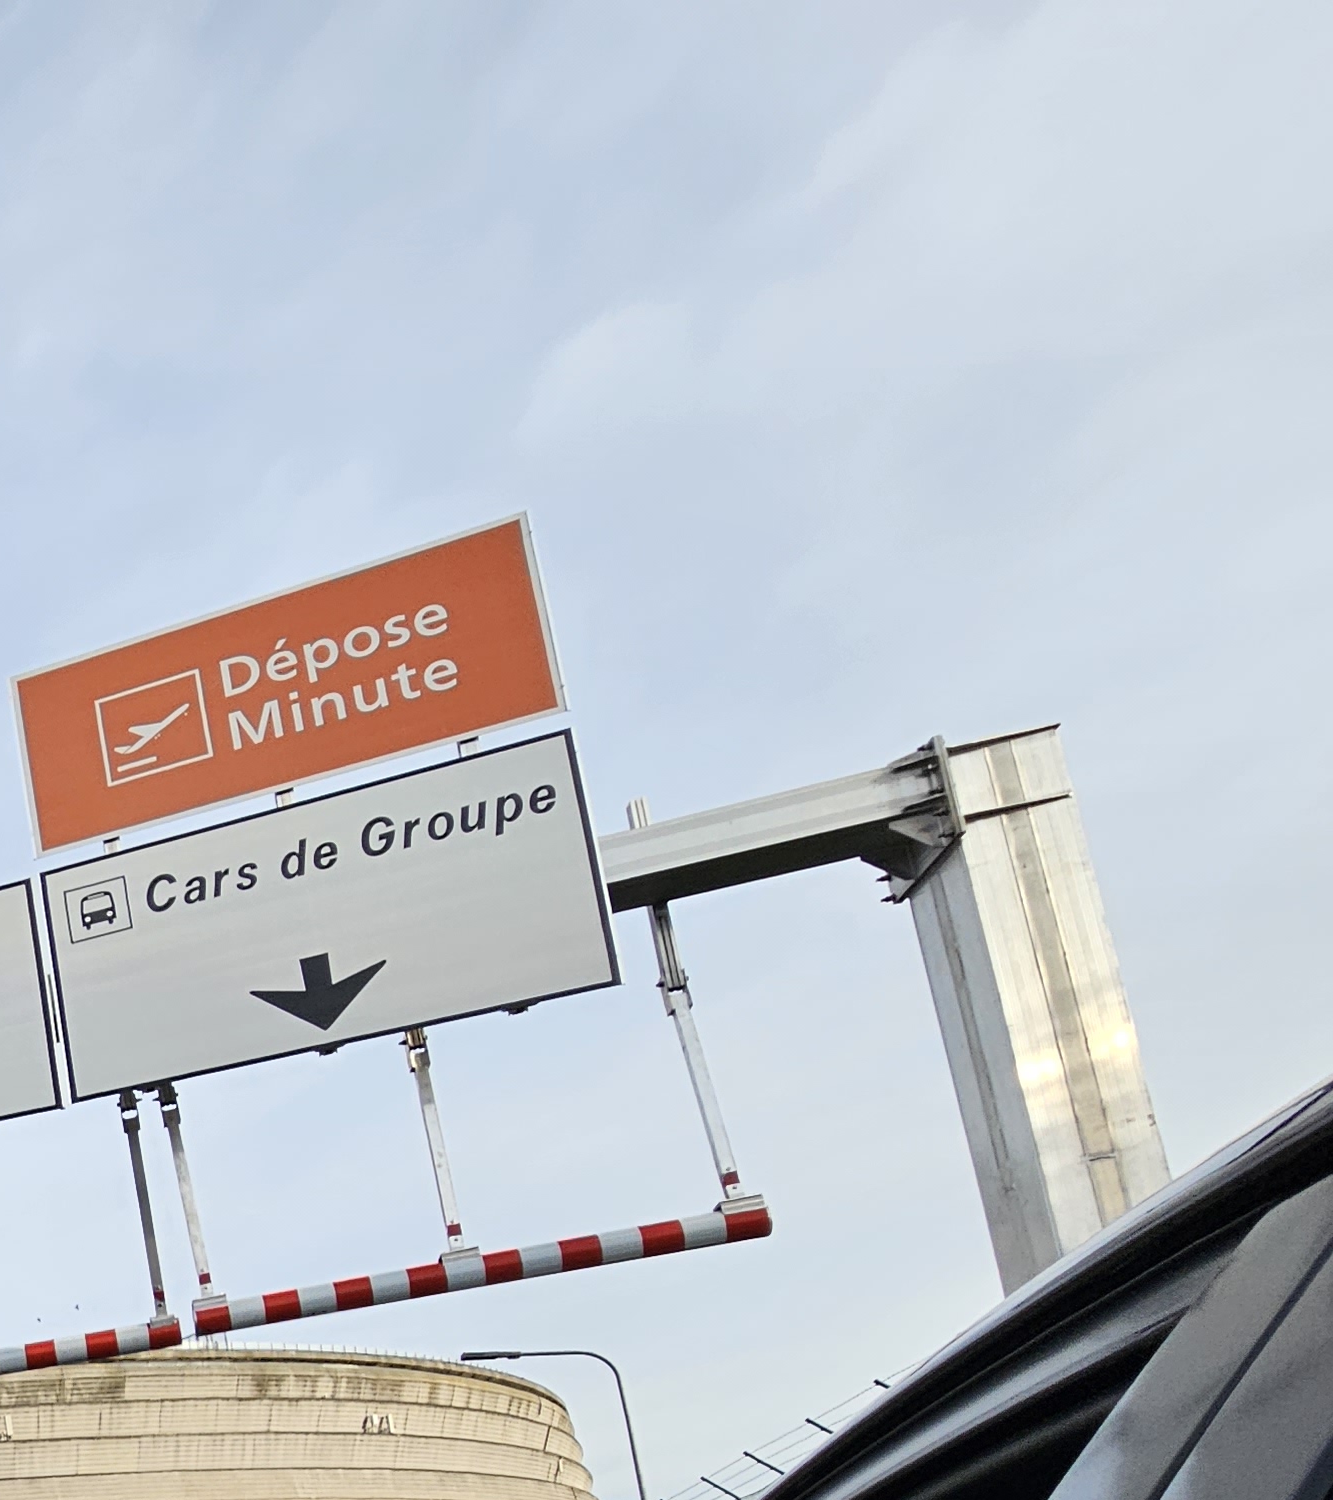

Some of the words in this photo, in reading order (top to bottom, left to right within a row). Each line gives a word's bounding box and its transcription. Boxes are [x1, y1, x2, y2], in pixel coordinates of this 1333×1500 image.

[218, 602, 449, 699] Dépose
[227, 658, 459, 751] Minute
[145, 863, 259, 913] Cars
[280, 837, 339, 879] de
[360, 783, 557, 858] Groupe
